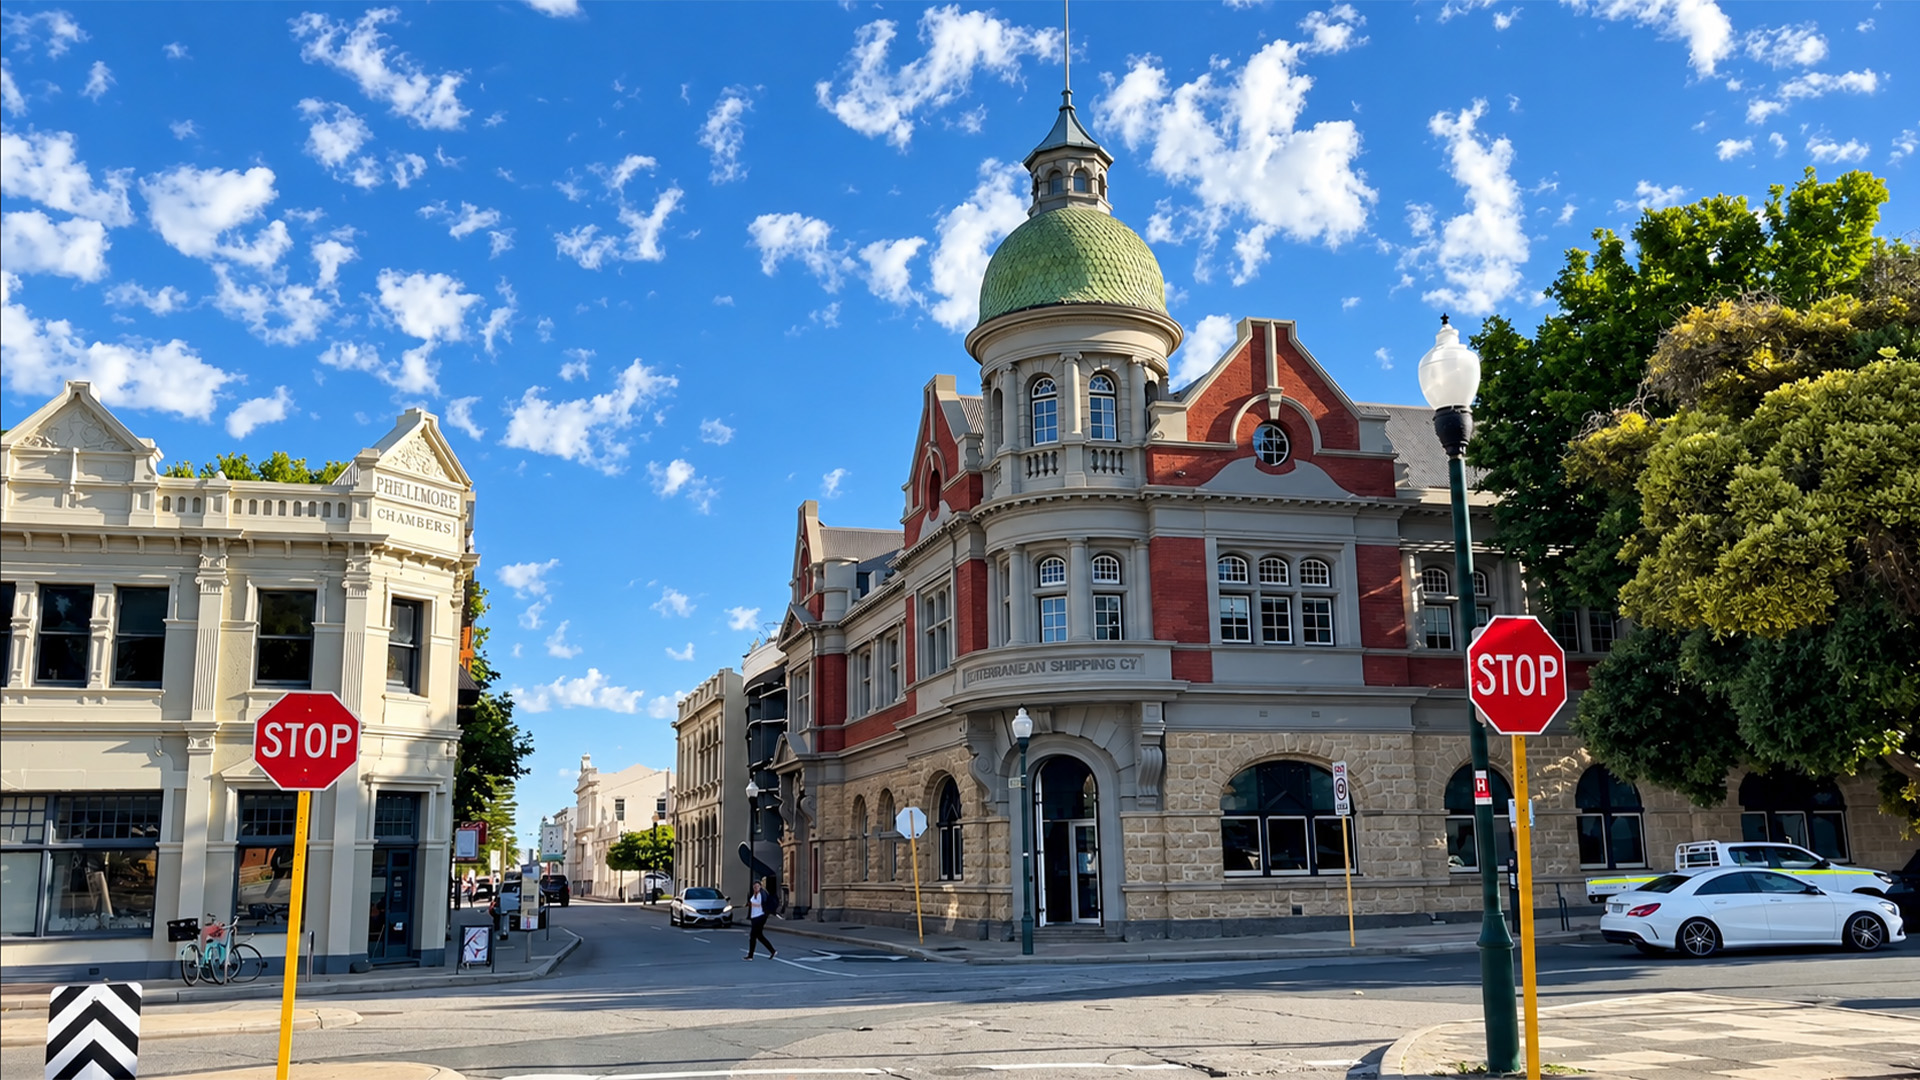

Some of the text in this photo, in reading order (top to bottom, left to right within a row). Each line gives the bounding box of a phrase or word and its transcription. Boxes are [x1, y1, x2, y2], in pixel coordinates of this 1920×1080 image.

[377, 508, 451, 534] CHAMBERS
[1050, 658, 1116, 672] SHIPPING
[1120, 658, 1138, 670] CY
[1477, 652, 1558, 696] STOP
[261, 722, 353, 759] STOP
[1476, 779, 1486, 792] H
